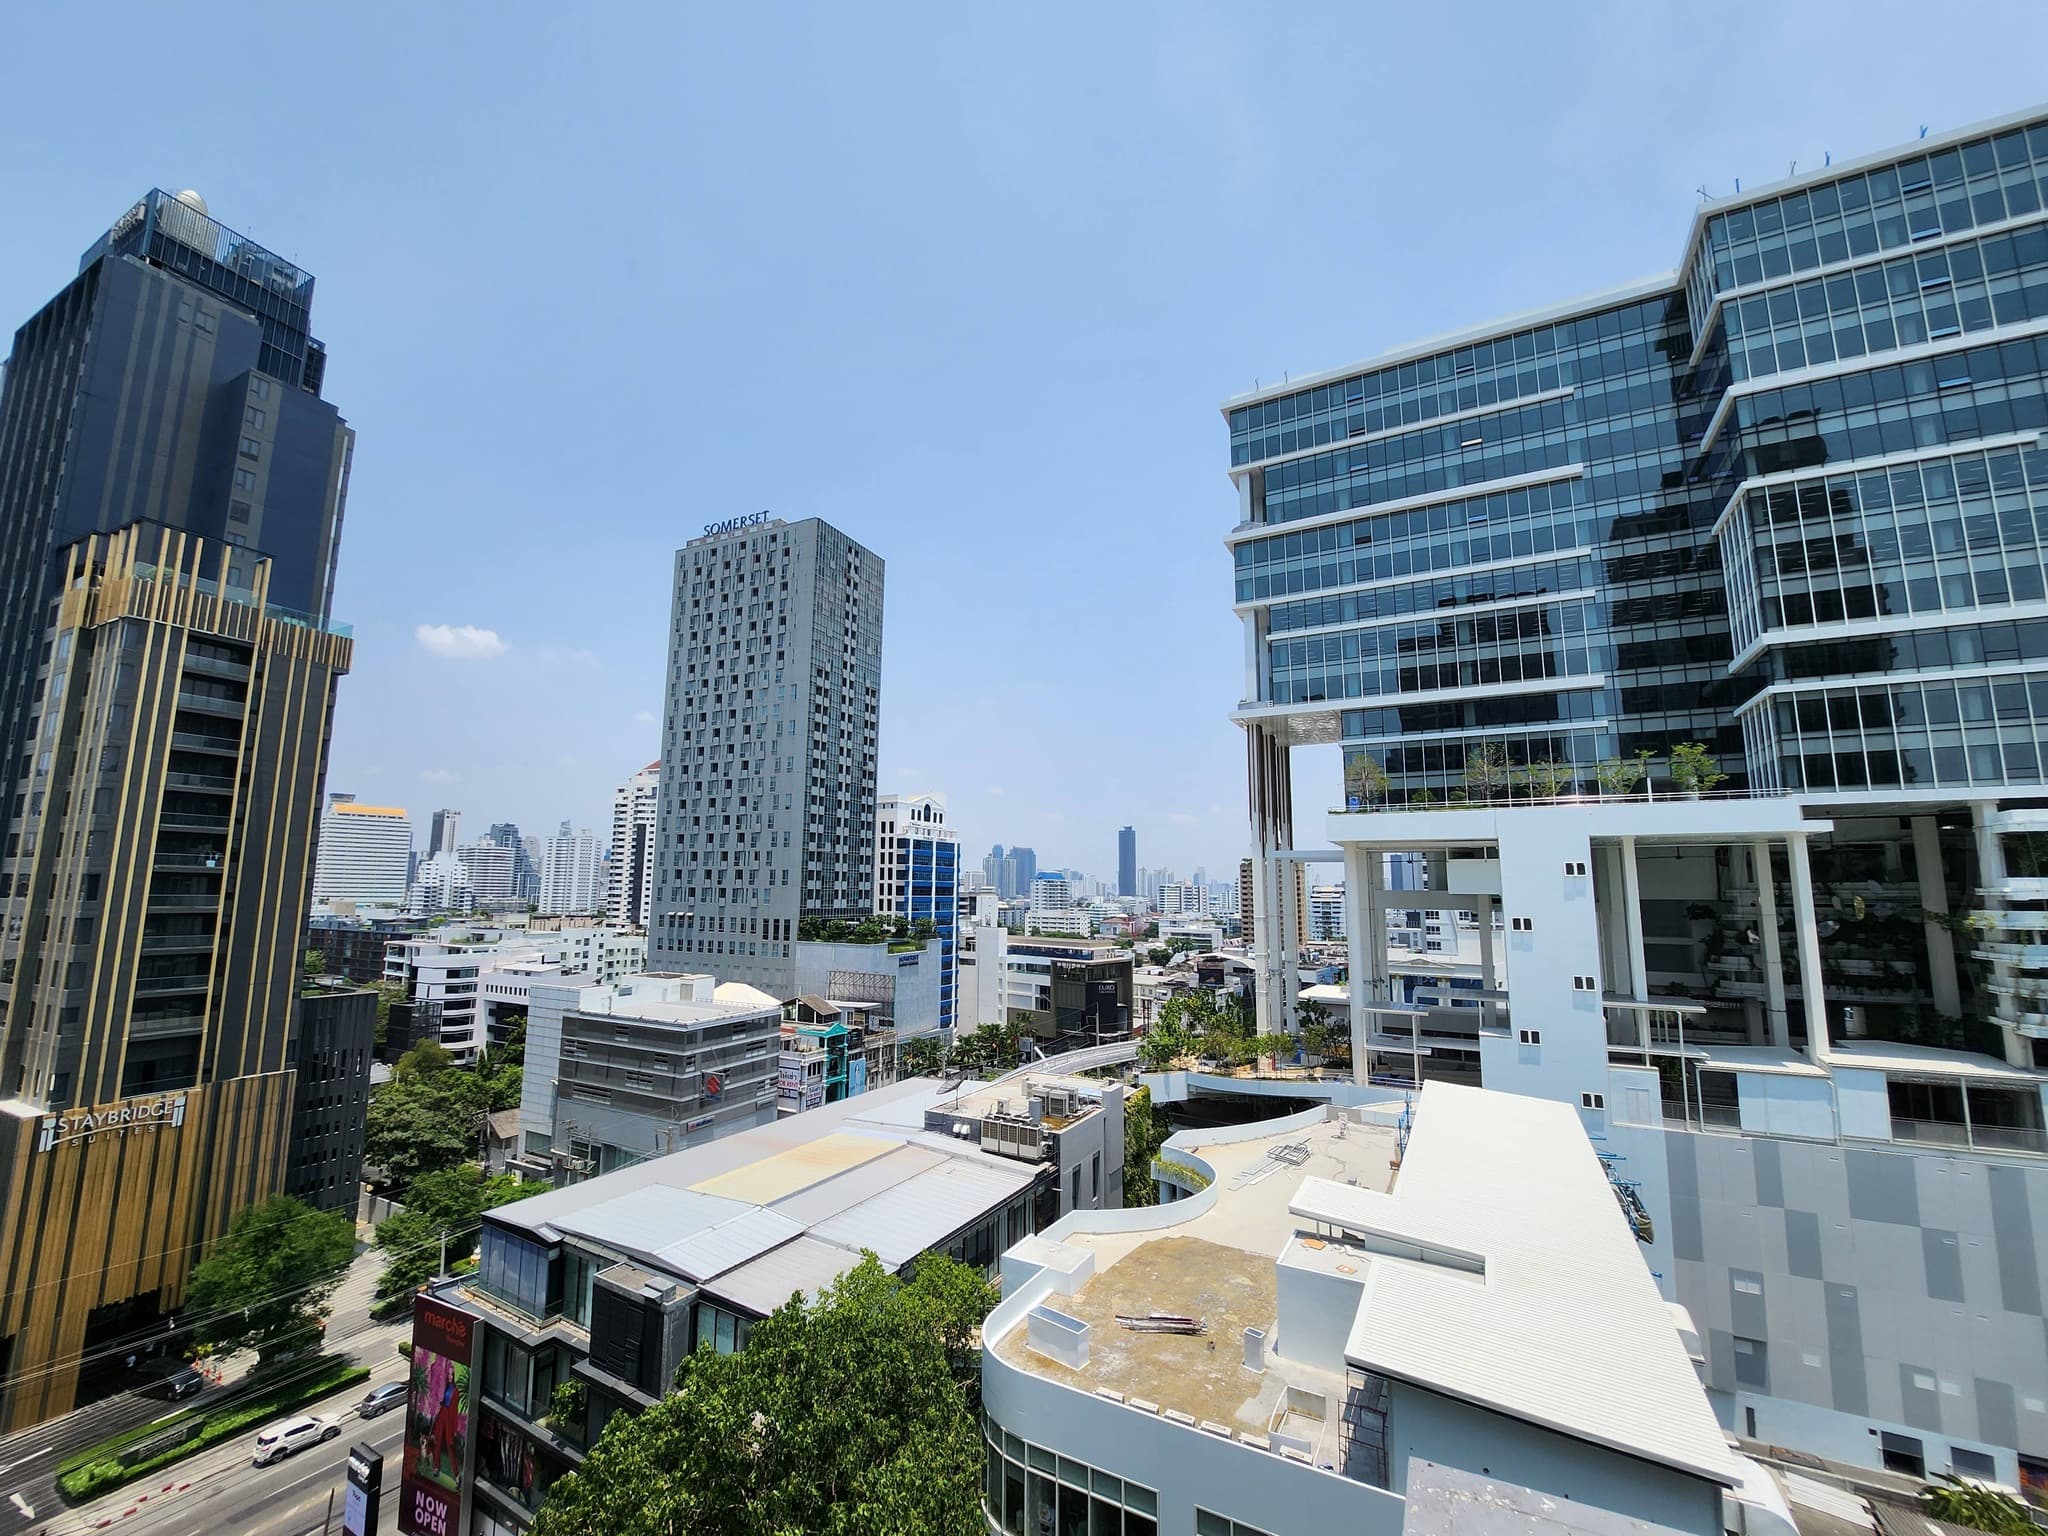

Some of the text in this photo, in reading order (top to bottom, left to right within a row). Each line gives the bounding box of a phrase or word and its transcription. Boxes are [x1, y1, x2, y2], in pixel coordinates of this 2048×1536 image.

[703, 510, 769, 537] SOMERSET
[56, 1101, 173, 1133] STAYBRIDGE
[71, 1126, 156, 1147] SUITES
[416, 1490, 447, 1519] NOW
[415, 1508, 447, 1536] OPEN
